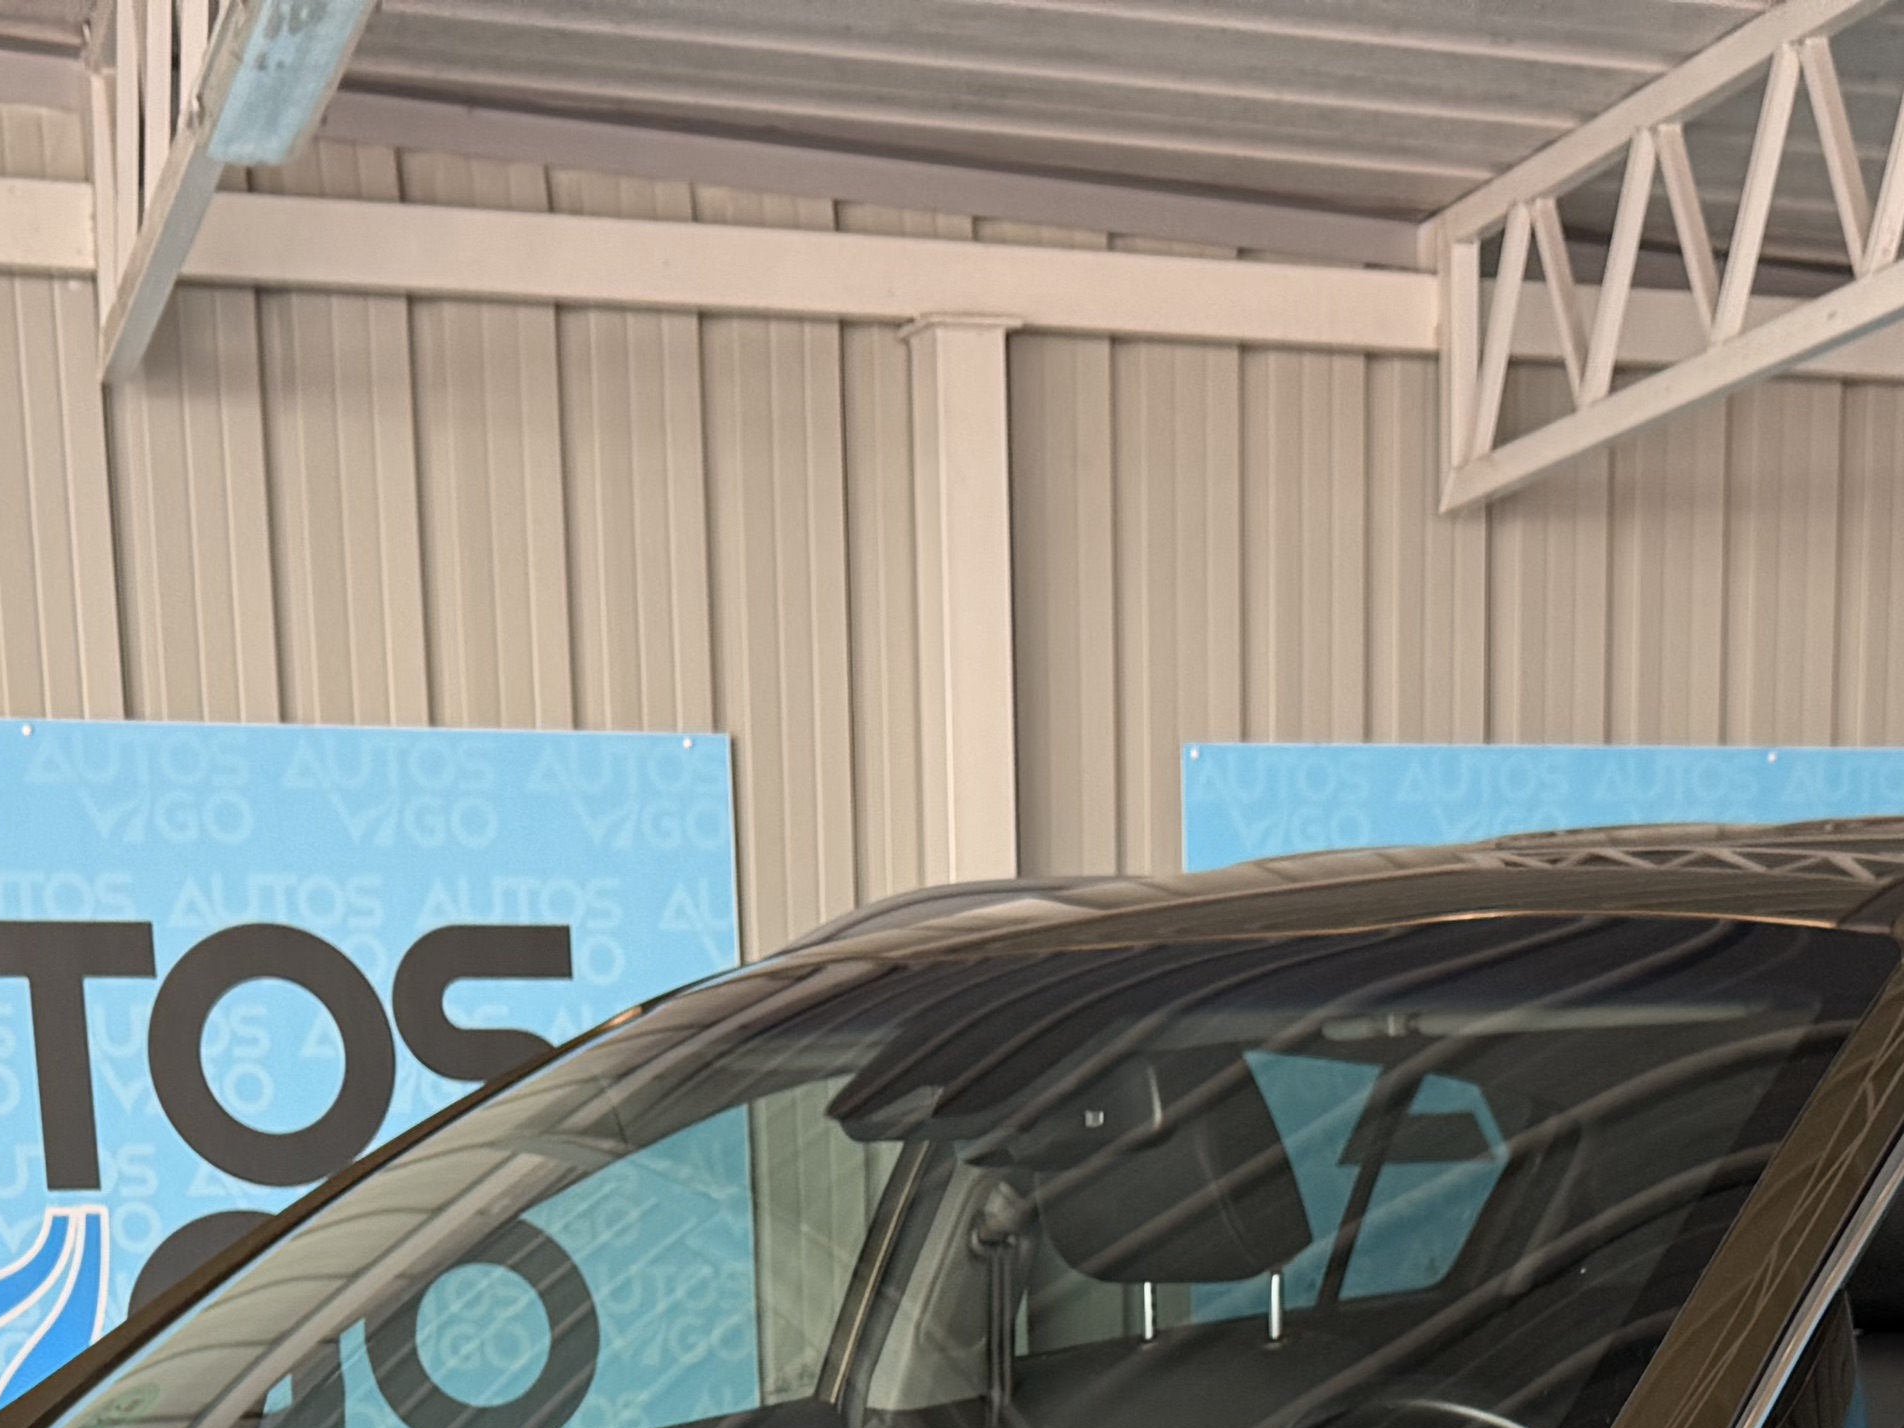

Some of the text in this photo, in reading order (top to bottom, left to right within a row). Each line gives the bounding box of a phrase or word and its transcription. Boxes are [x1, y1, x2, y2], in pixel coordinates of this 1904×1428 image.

[25, 730, 248, 785] AUTOS
[283, 735, 491, 790] AUTOS
[525, 739, 726, 793] AUTOS
[76, 785, 252, 844] VIGO
[334, 790, 497, 847] VIGO
[571, 794, 729, 850] VIGO
